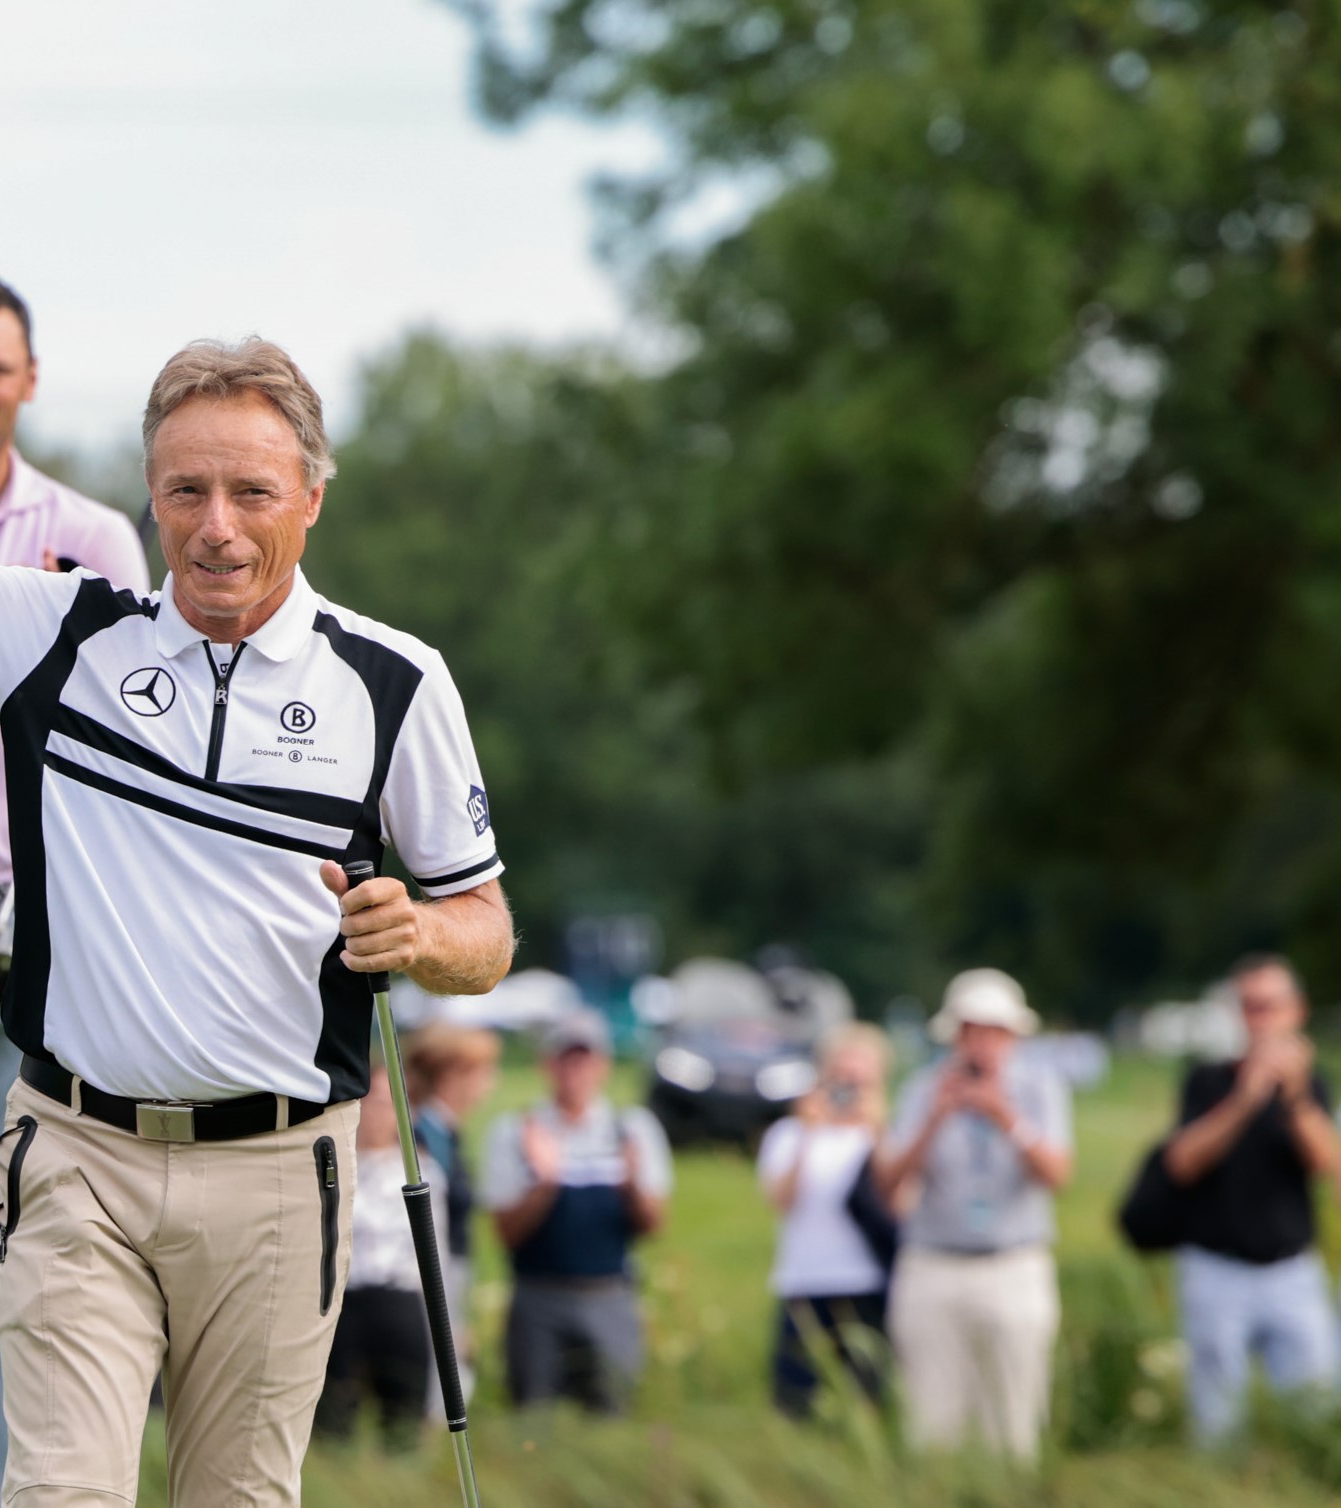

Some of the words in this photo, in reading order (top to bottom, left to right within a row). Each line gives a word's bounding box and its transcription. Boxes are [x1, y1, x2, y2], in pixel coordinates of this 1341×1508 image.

[292, 708, 306, 727] B
[277, 736, 315, 746] BOGNER
[252, 748, 284, 758] BOGNER
[307, 755, 338, 765] LANGER
